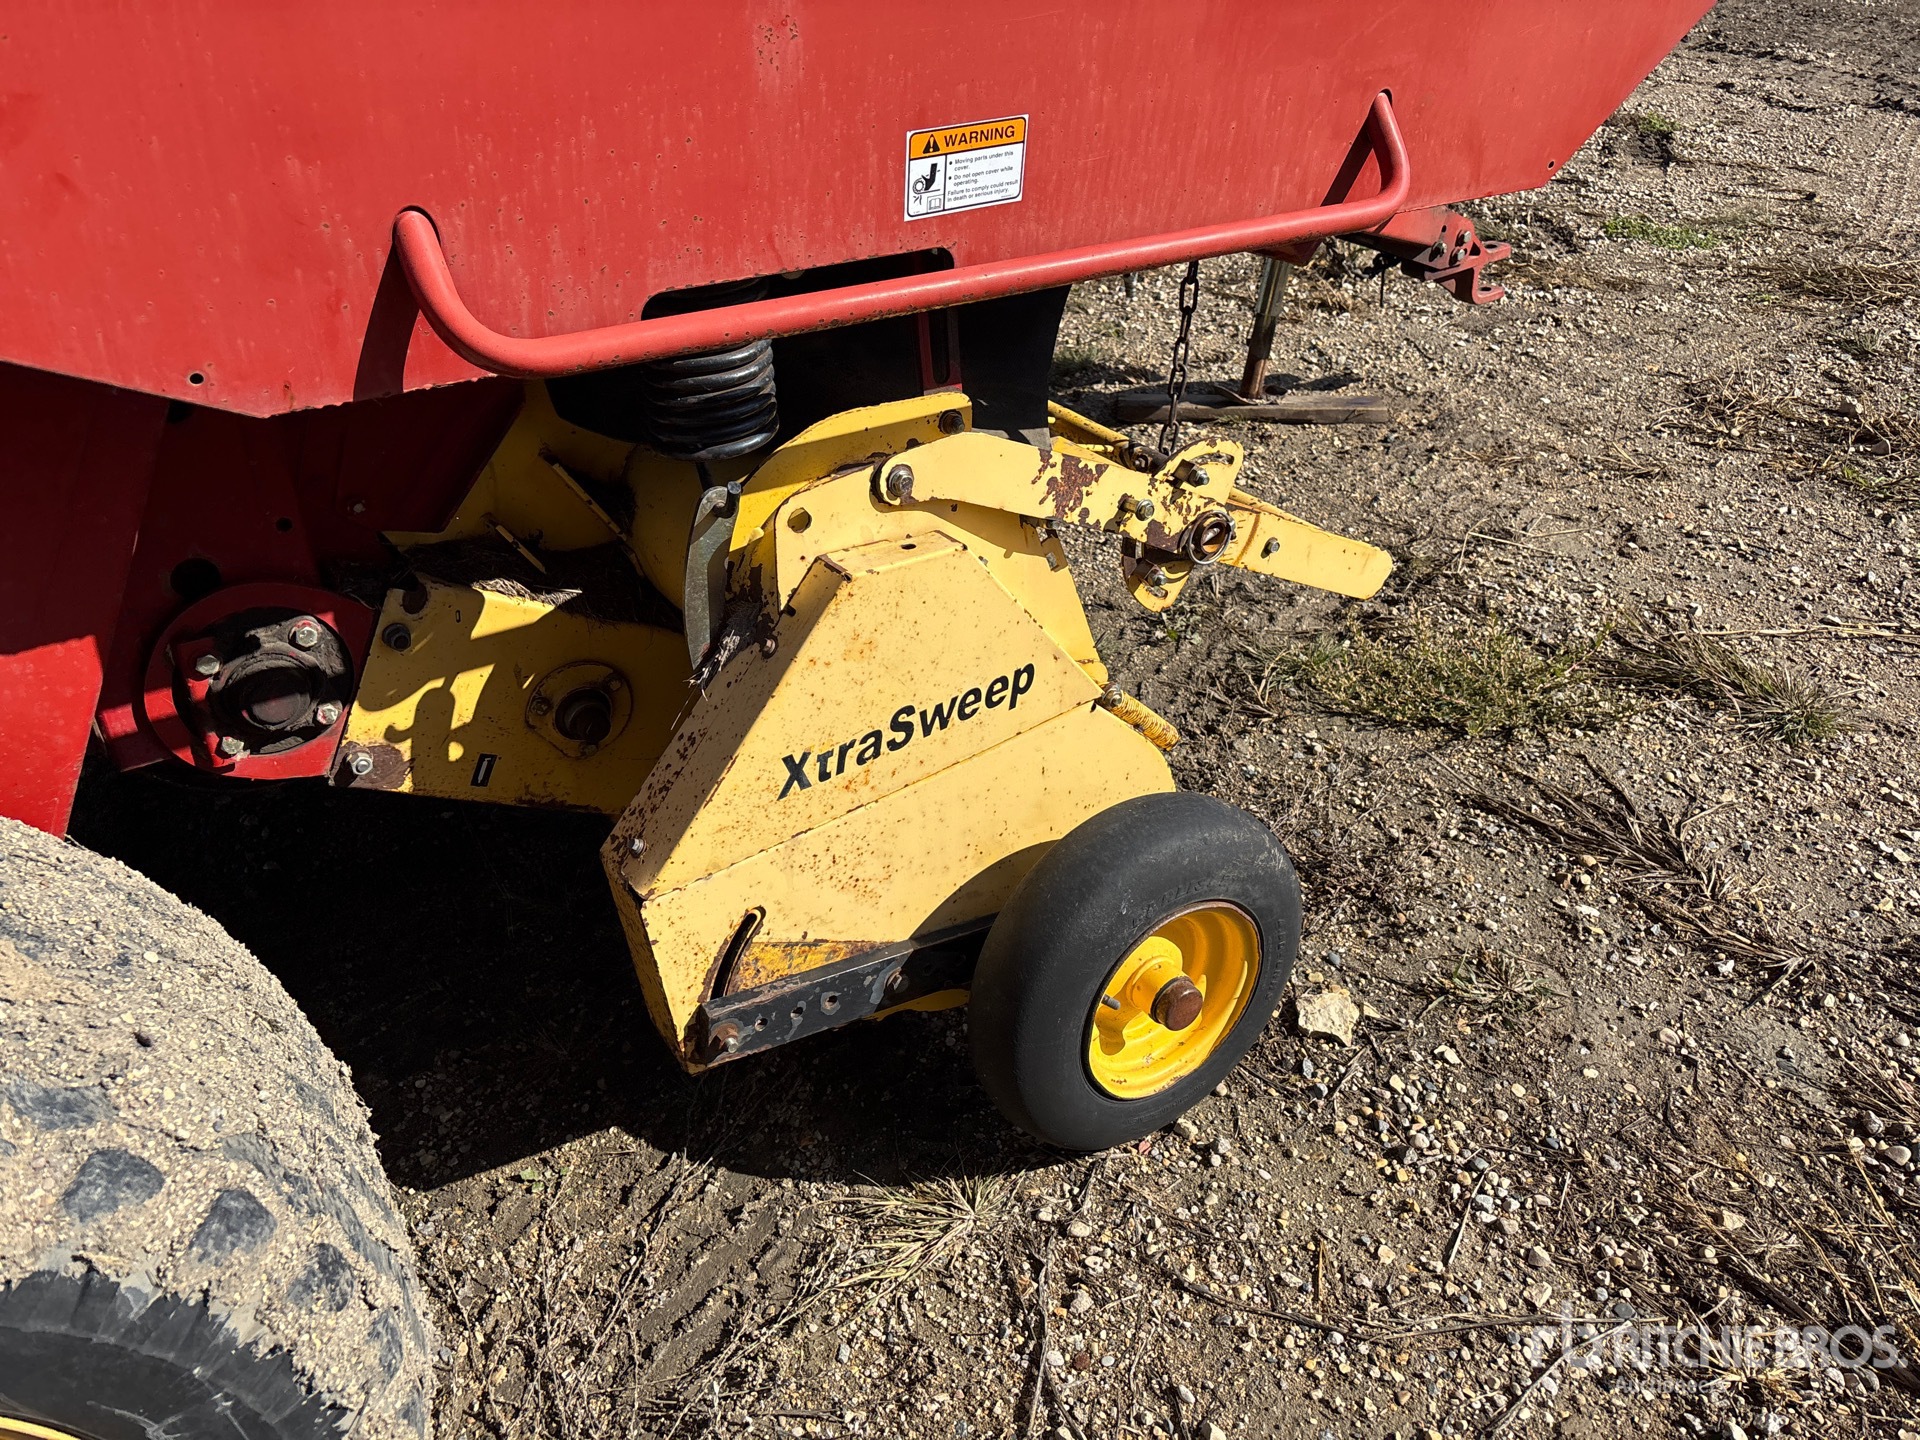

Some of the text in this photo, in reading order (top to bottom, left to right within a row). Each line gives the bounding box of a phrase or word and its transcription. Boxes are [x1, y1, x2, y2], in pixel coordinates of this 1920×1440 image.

[944, 125, 1015, 148] WARNING
[954, 157, 973, 165] Moving
[974, 155, 988, 163] parts
[972, 170, 985, 178] open
[953, 178, 979, 187] operating.
[971, 184, 989, 192] comply
[990, 181, 1004, 189] could
[953, 194, 967, 202] death
[974, 190, 993, 198] serious
[993, 187, 1009, 196] injury.
[776, 663, 1035, 801] XtraSweep
